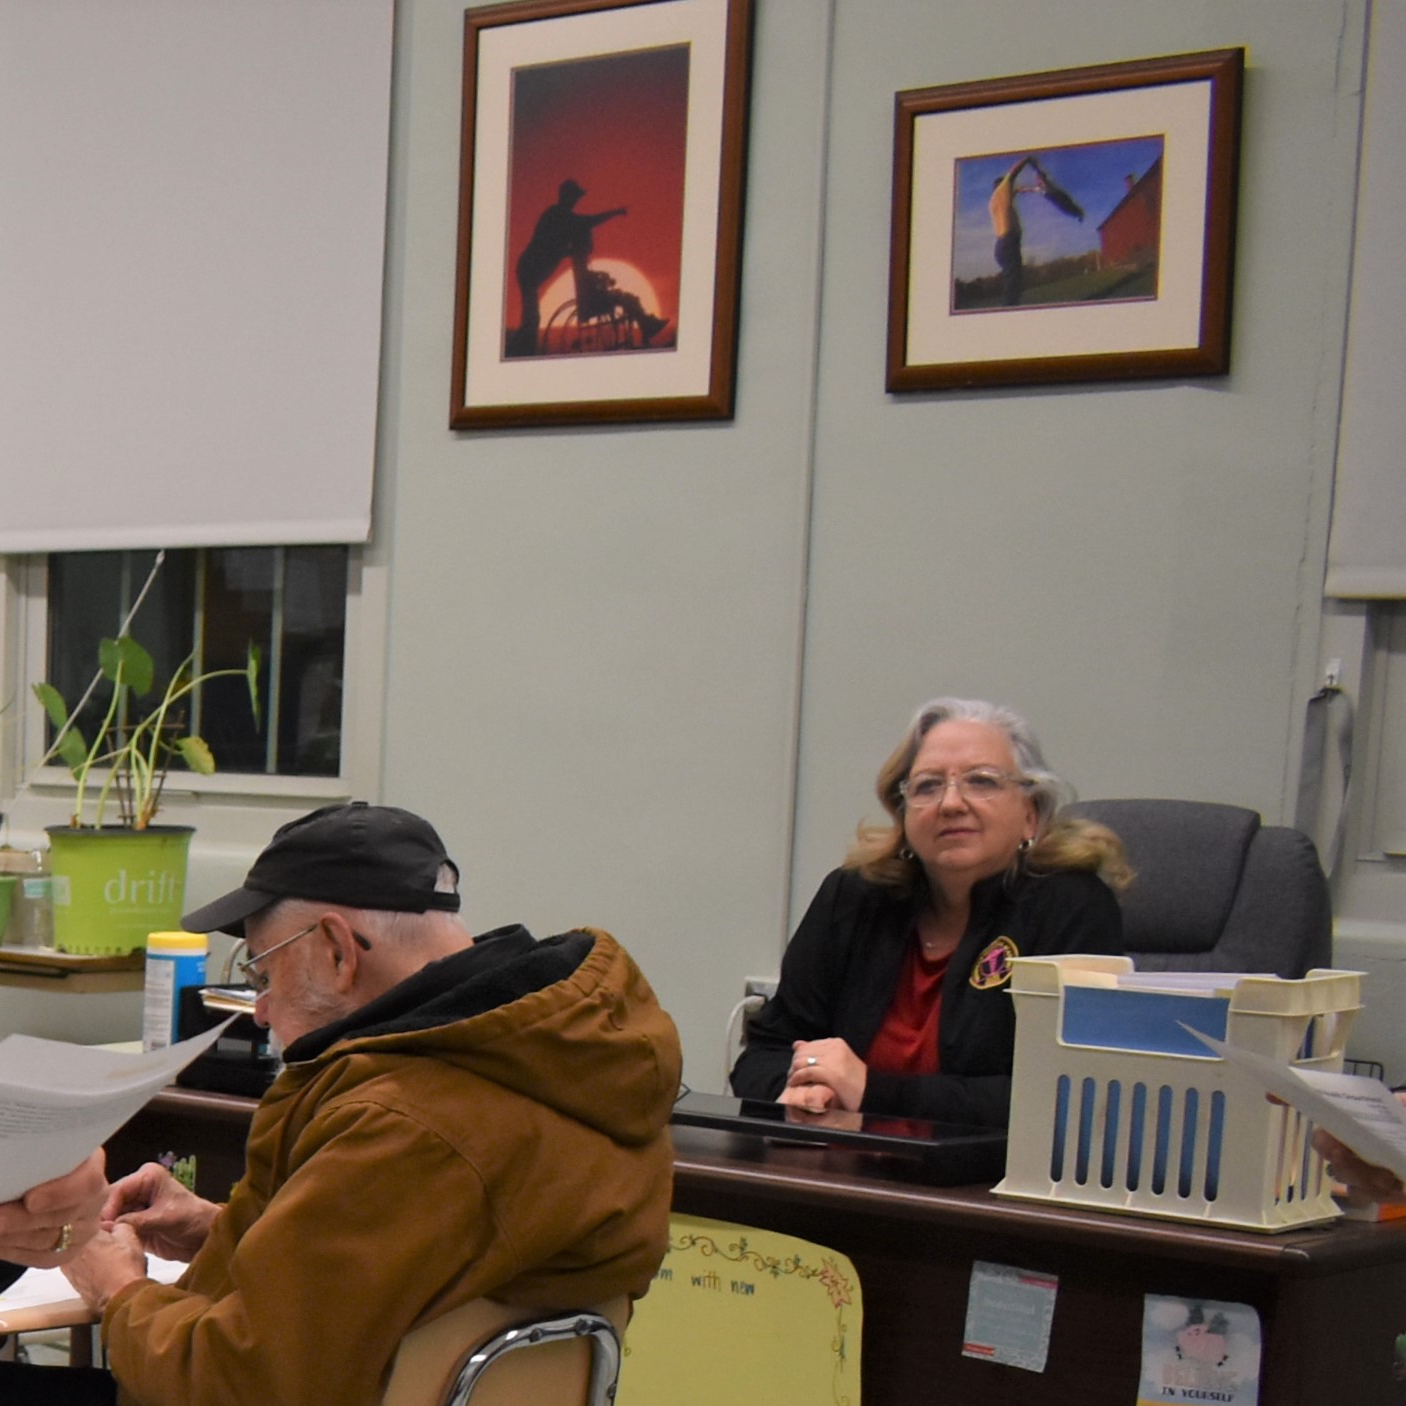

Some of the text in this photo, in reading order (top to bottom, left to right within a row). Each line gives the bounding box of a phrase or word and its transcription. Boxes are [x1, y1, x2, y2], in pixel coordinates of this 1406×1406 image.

[103, 867, 179, 905] drift
[691, 1268, 722, 1293] with
[730, 1280, 756, 1297] new
